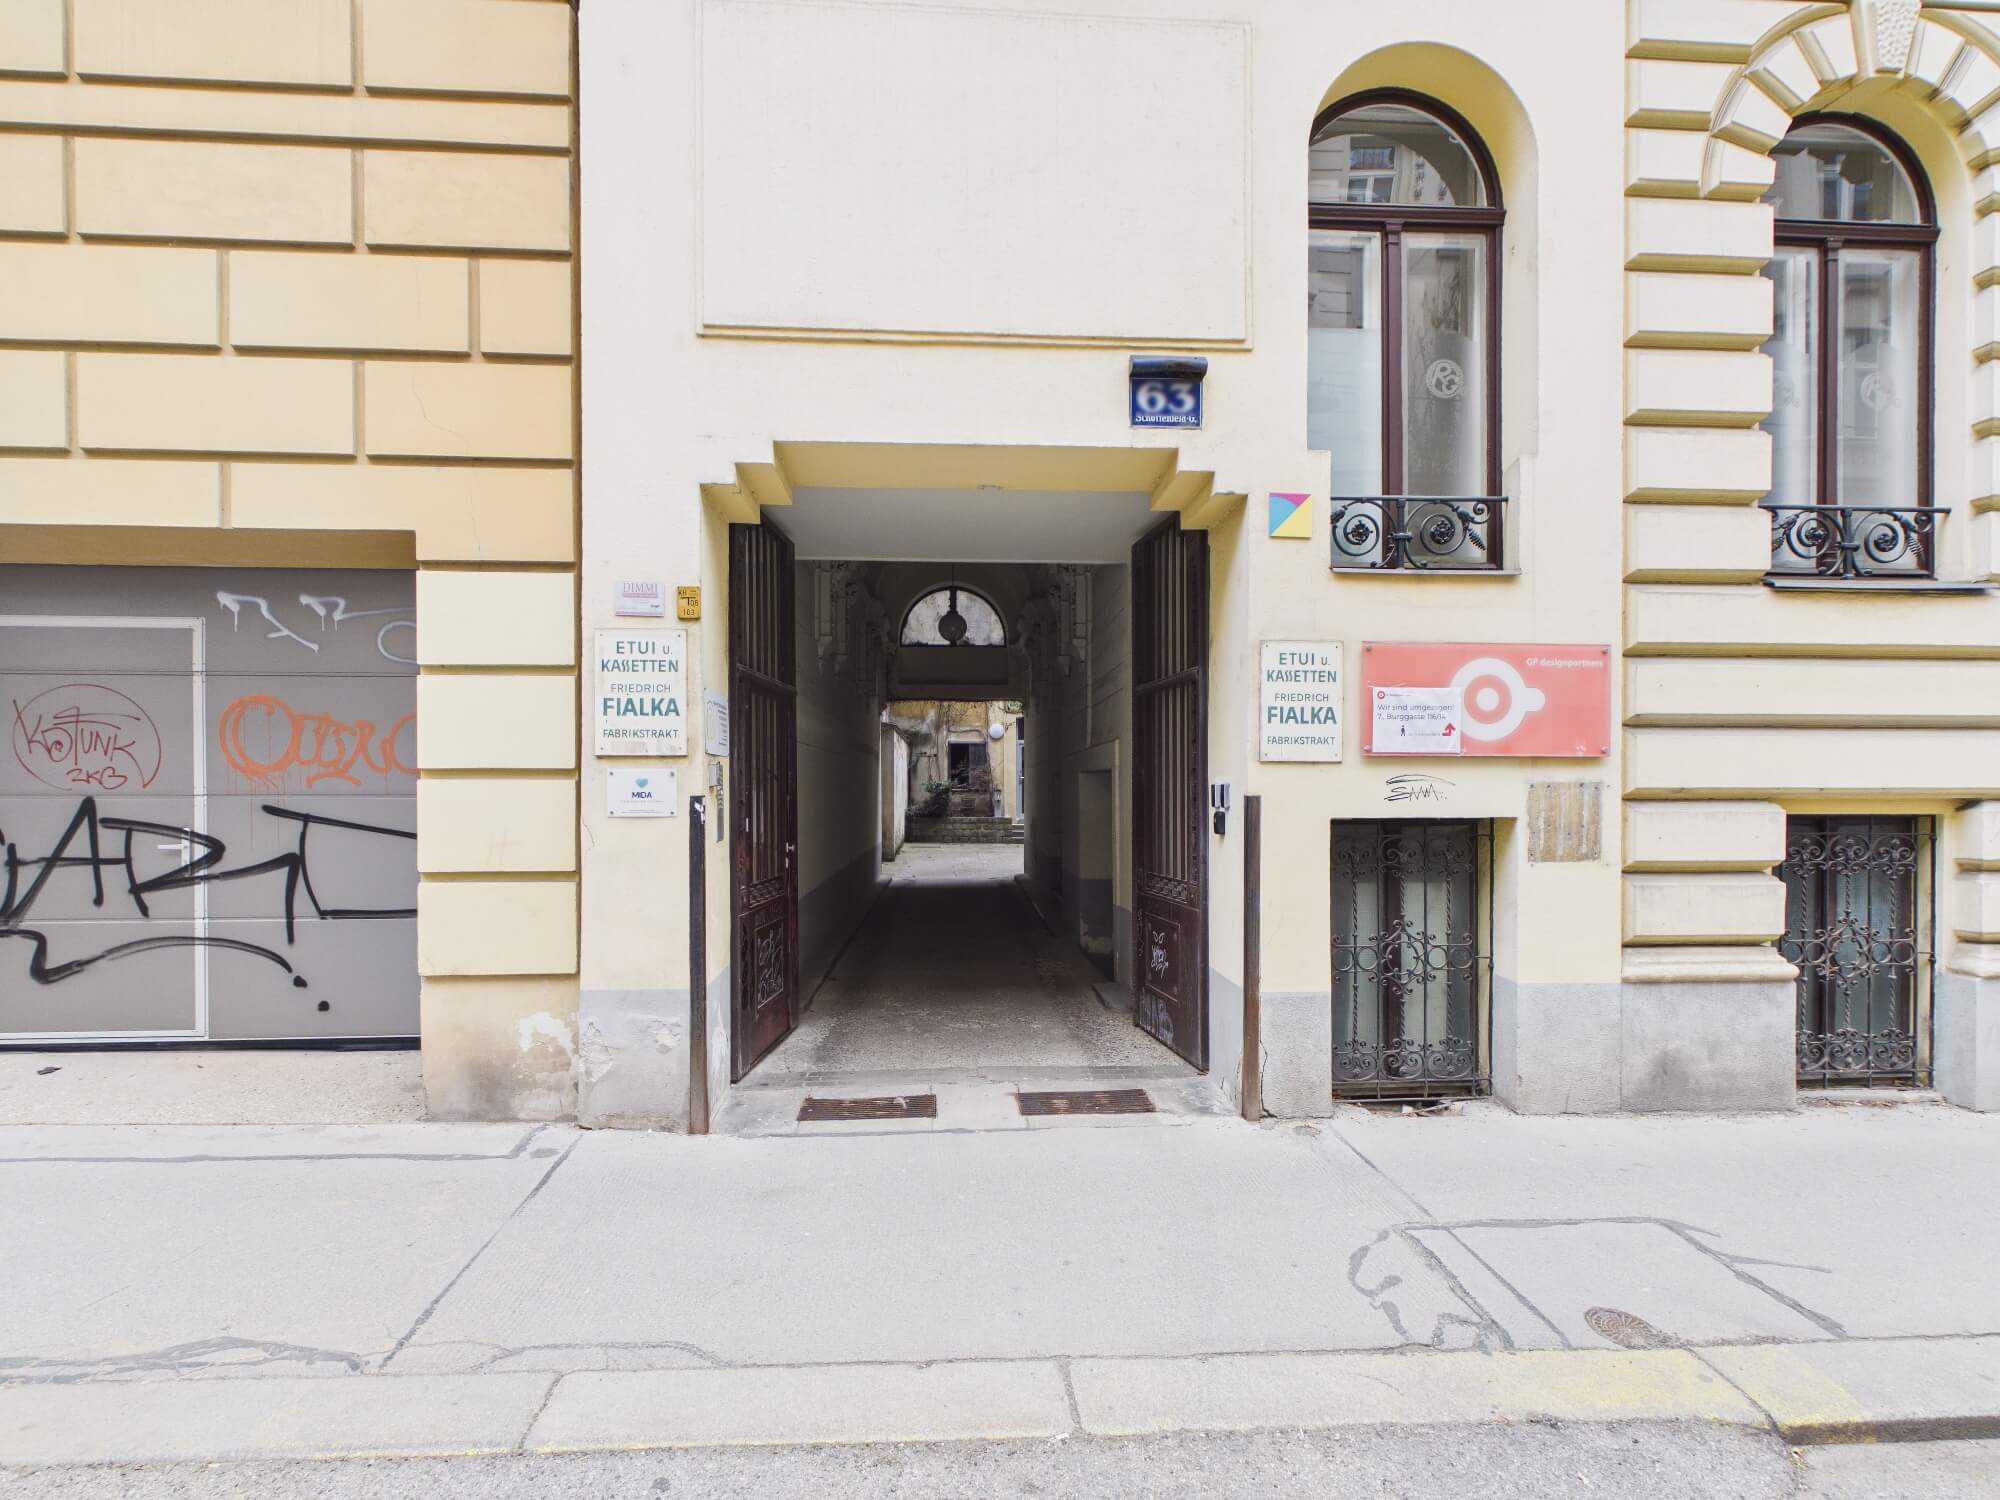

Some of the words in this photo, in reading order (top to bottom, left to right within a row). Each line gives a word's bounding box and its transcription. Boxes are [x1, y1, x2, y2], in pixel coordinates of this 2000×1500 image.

[1136, 382, 1195, 413] 63
[623, 582, 658, 593] DIMMI
[616, 640, 656, 655] ETUI
[1279, 652, 1315, 666] ETUI
[601, 659, 679, 673] KASSETTEN
[1266, 670, 1337, 683] KASSETTEN
[610, 683, 671, 693] FRIEDRICH
[1275, 692, 1329, 702] FRIEDRICH
[602, 697, 680, 717] FIALKA
[1267, 706, 1337, 725] FIALKA
[602, 729, 679, 739] FABRIKSTRAKT
[1267, 736, 1336, 745] FABRIKSTRAKT
